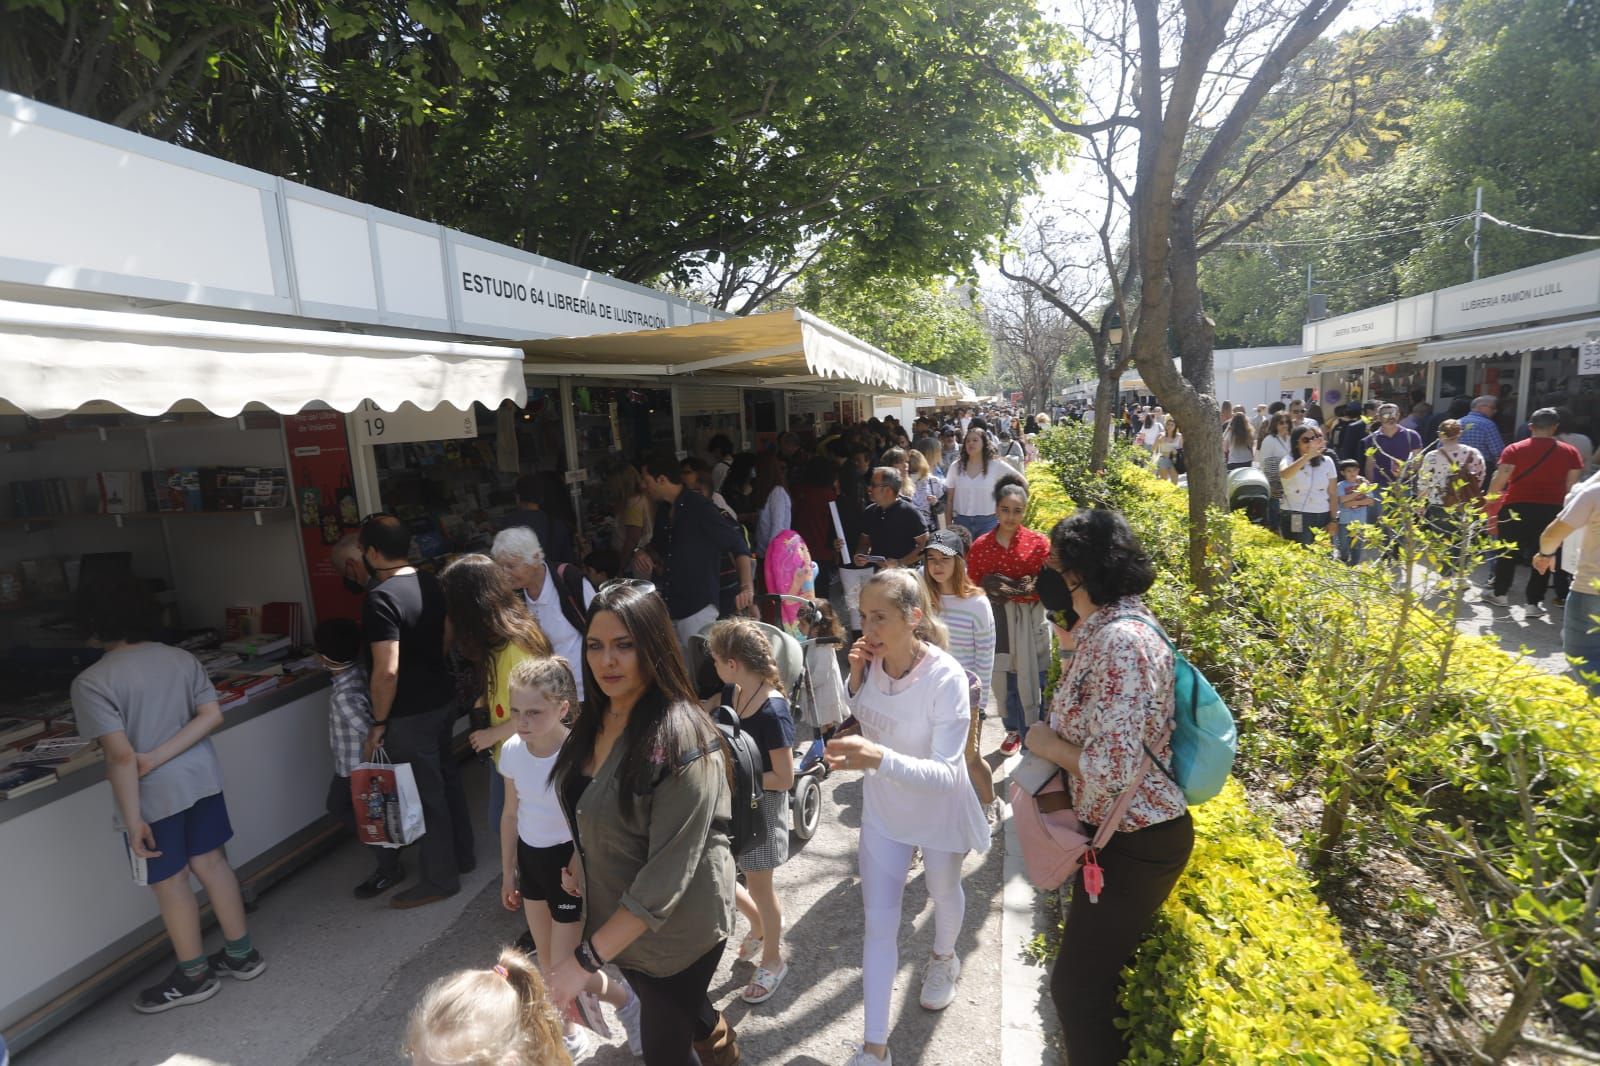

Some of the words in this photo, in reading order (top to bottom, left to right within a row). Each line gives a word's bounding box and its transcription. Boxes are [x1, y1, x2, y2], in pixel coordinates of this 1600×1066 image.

[462, 271, 527, 302] ESTUDIO
[530, 287, 544, 305] 64
[547, 291, 597, 317] LIBRERÍA
[599, 303, 612, 320] DE
[613, 306, 666, 329] ILUSTRACIÓN
[1500, 287, 1532, 304] RAMON
[1533, 281, 1563, 298] LLULL
[1584, 344, 1600, 356] 53
[1584, 358, 1600, 370] 54
[364, 417, 385, 437] 19
